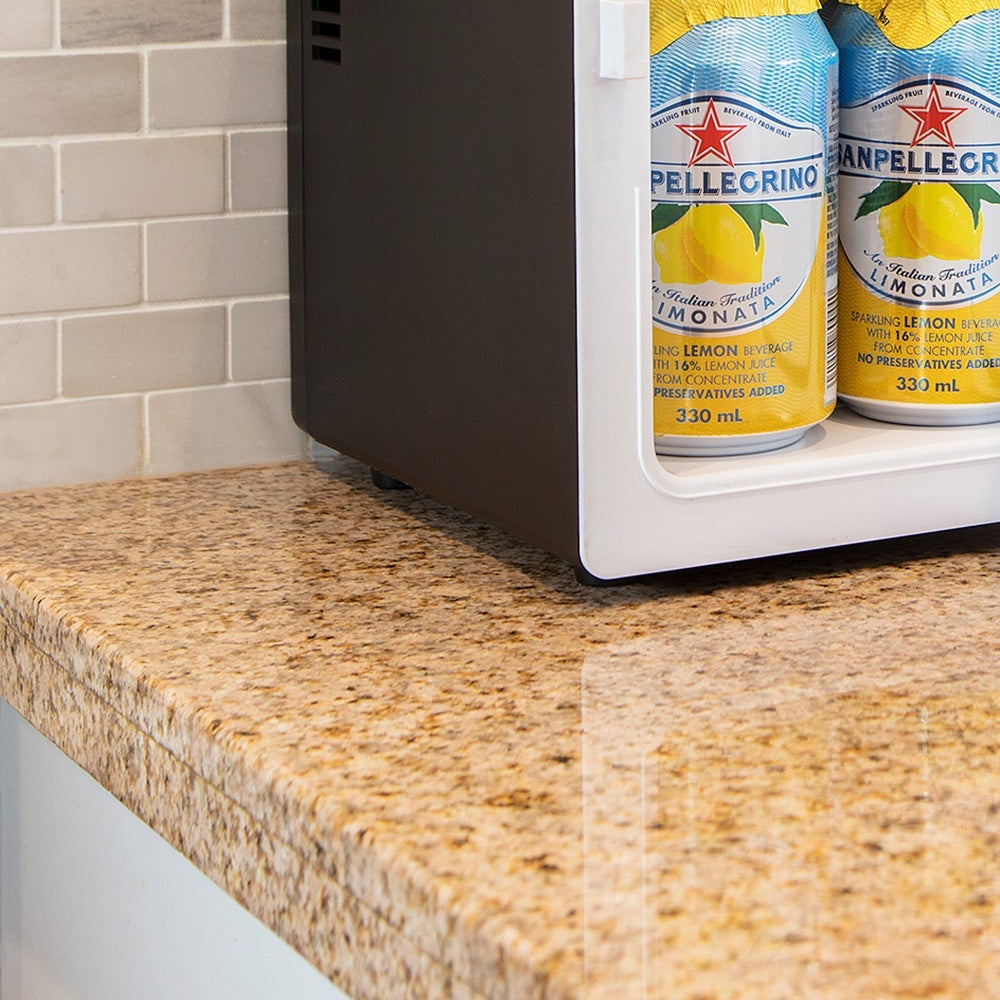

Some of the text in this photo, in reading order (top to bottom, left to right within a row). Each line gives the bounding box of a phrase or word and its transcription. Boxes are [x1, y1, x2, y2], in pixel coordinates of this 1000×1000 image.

[871, 94, 904, 112] SPARKLING
[905, 89, 923, 98] FRUIT
[945, 90, 978, 107] BEVERAGE
[979, 103, 995, 116] FROM
[651, 106, 792, 139] ARKLING FRUIT BEVERAGE FROM ITALY
[651, 165, 818, 196] PELLEGRINO
[863, 250, 1000, 282] An Italian Tradition
[663, 289, 716, 307] Italian
[720, 275, 782, 306] Tradition
[870, 268, 993, 298] LIMONATA
[657, 295, 775, 324] IMONATA
[851, 311, 901, 328] SPARKLING
[904, 316, 956, 330] LEMON
[866, 327, 993, 343] WITH 16% LEMON JUICE
[683, 344, 738, 357] LEMON
[743, 341, 794, 356] BEVERAGE
[874, 343, 984, 356] FROM CONCENTRATE
[653, 357, 776, 371] ITH 16% LEMON JUICE
[858, 353, 874, 364] NO
[876, 355, 962, 370] PRESERVATIVES
[686, 372, 768, 385] CONCENTRATE
[896, 377, 960, 393] 330 mL
[654, 384, 785, 399] PRESERVATIVES ADDED
[676, 408, 743, 423] 330 mL
